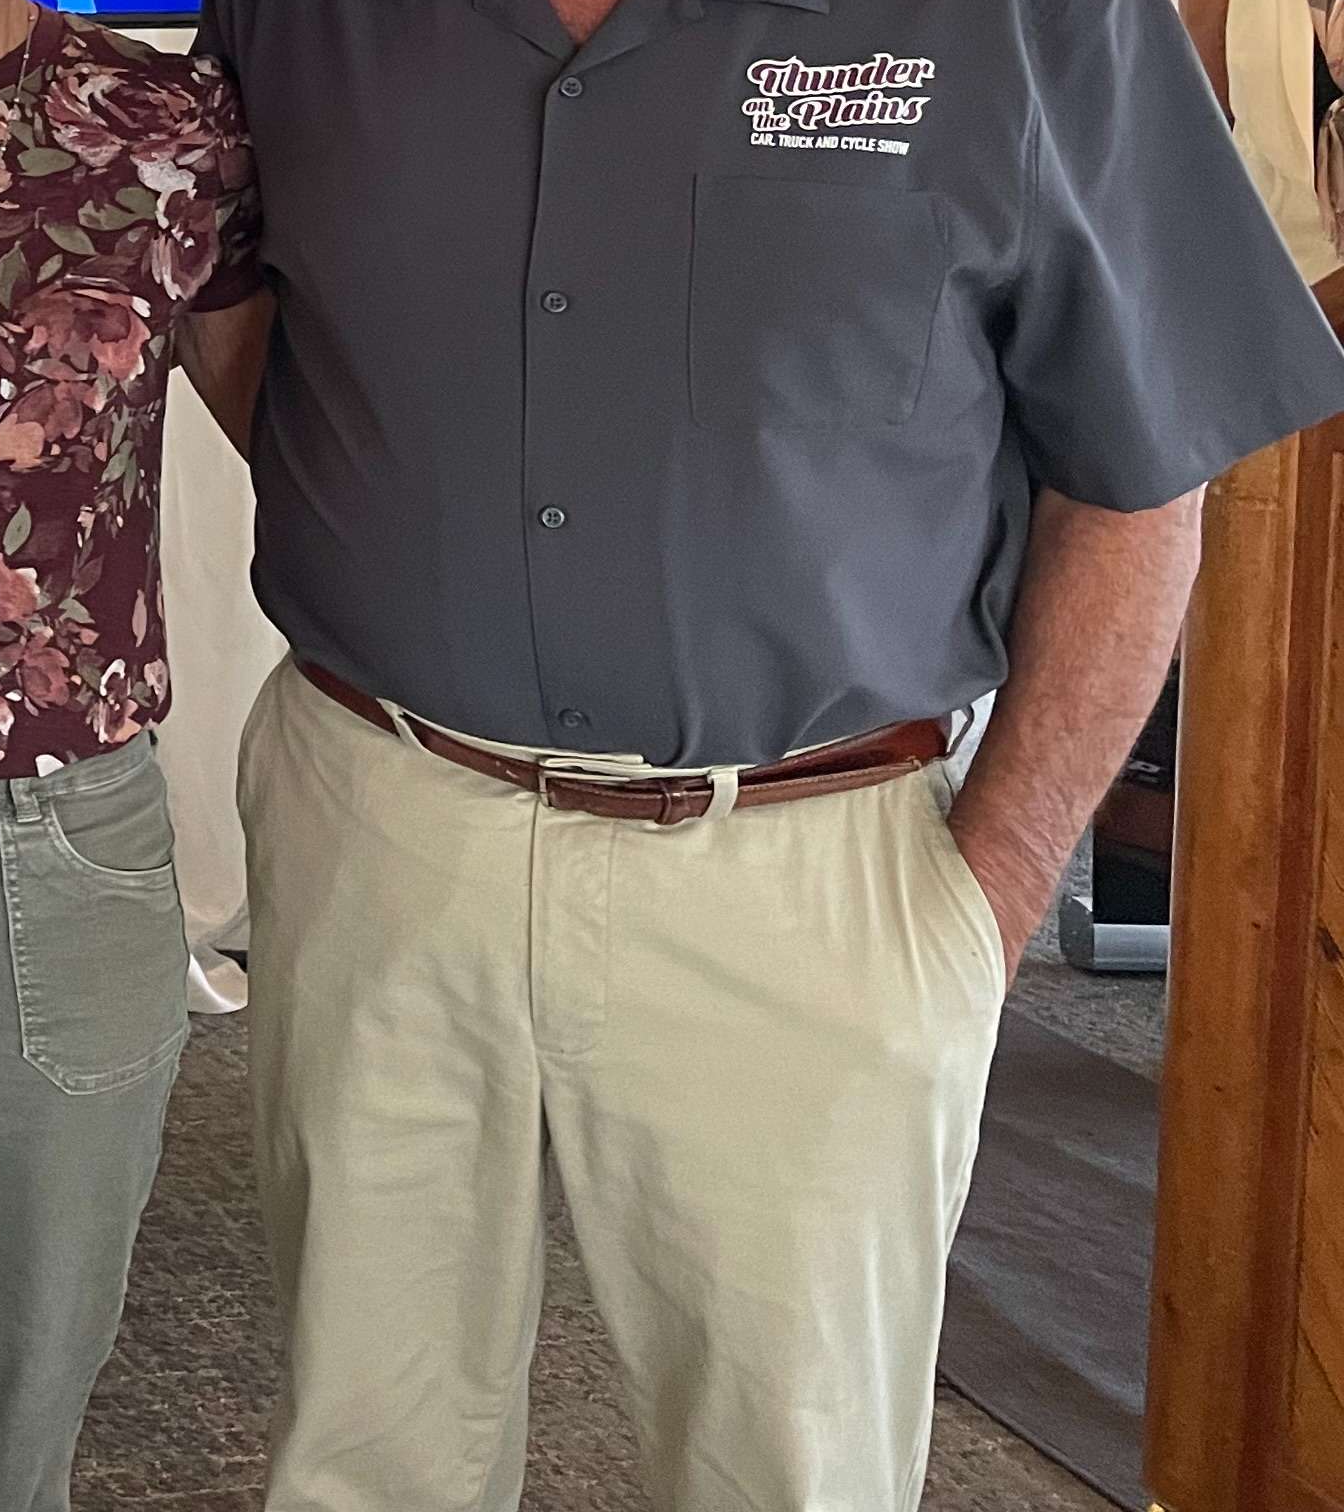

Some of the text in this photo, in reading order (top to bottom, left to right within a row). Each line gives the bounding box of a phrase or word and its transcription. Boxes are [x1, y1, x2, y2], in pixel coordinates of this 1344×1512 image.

[747, 53, 935, 96] Thunder
[742, 91, 931, 132] on the Plains
[778, 134, 814, 149] TRUCK
[815, 136, 839, 149] AND
[840, 136, 877, 152] CYCLE
[877, 139, 910, 155] SHOW
